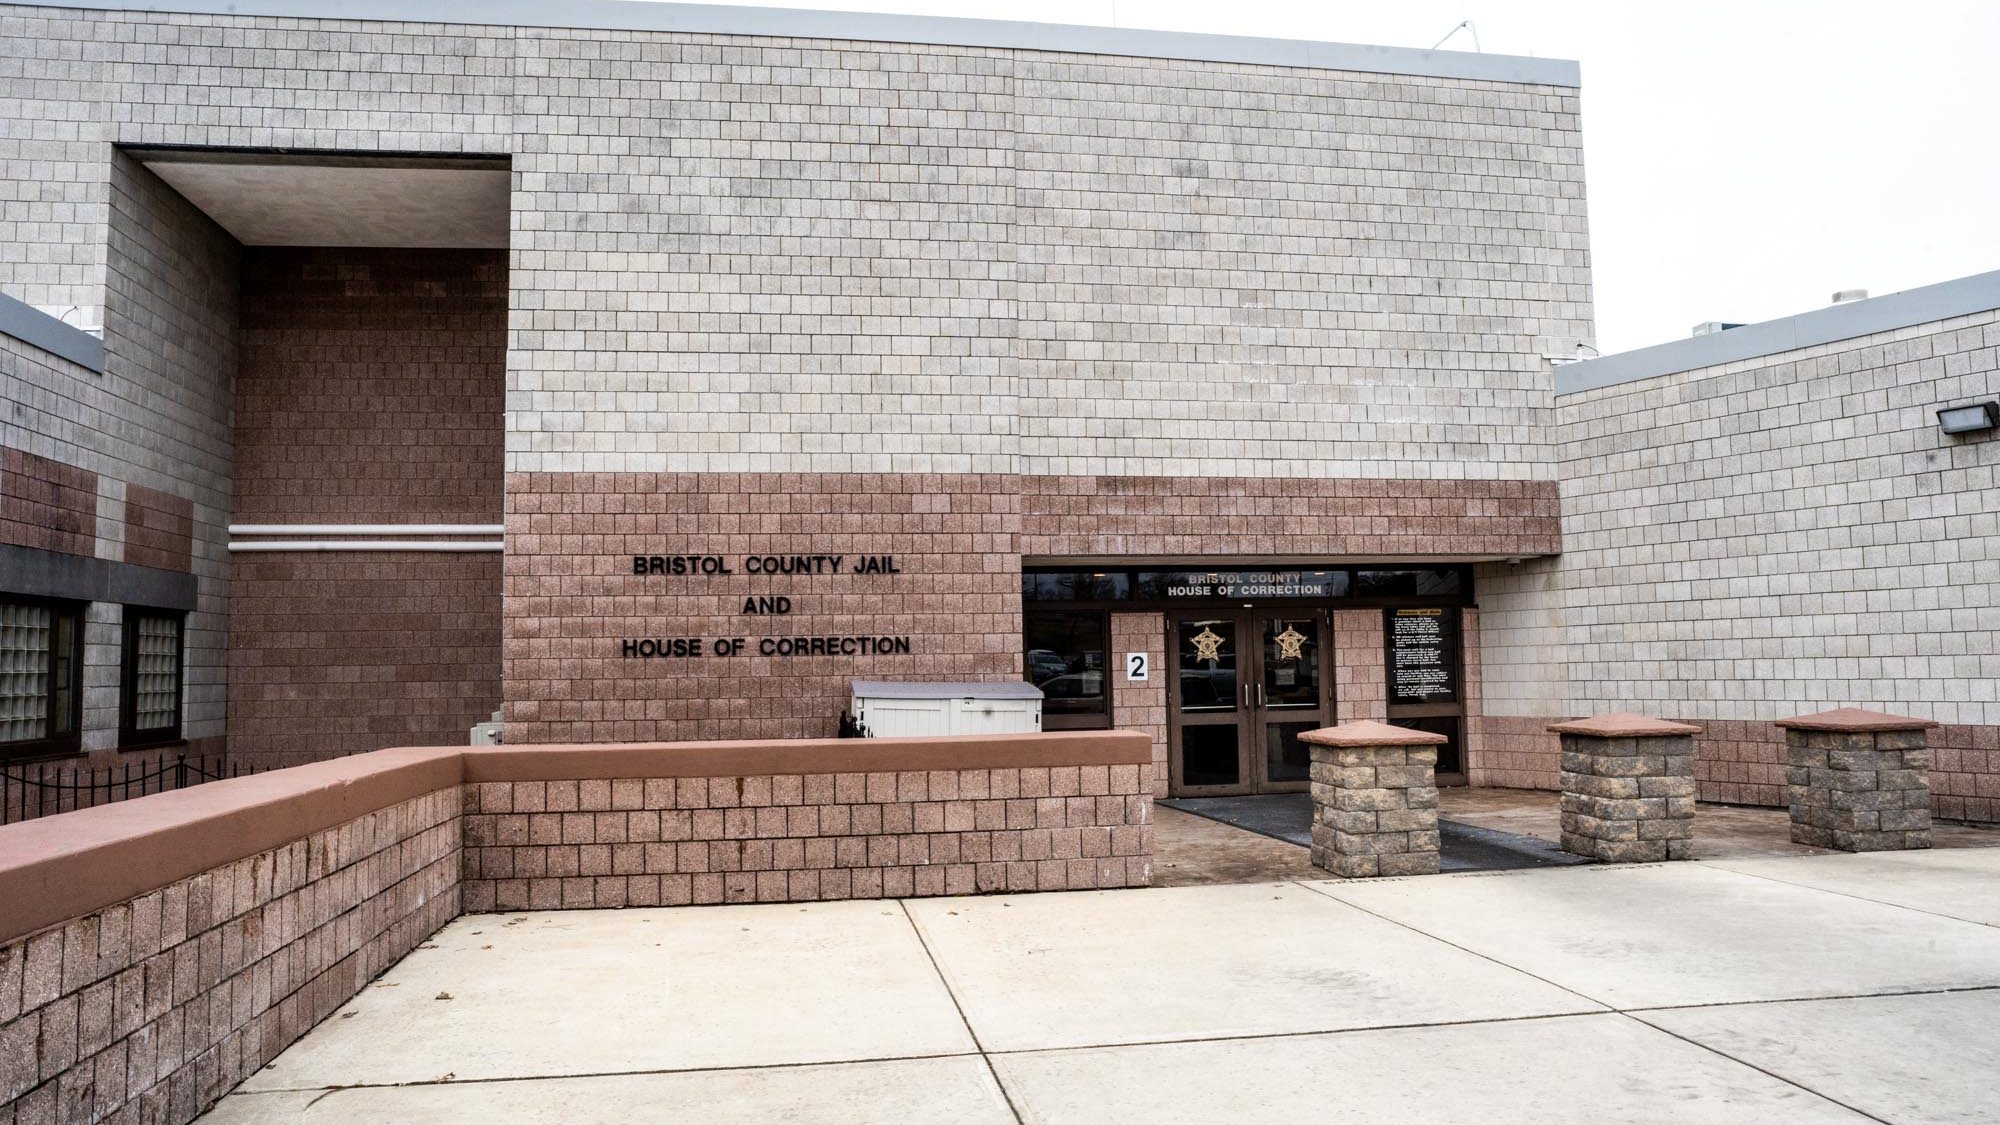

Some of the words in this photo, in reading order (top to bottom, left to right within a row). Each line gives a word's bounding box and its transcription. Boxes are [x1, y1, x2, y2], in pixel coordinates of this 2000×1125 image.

[633, 556, 731, 575] BRISTOL
[746, 555, 842, 574] COUNTY
[854, 555, 900, 574] JAIL
[1189, 574, 1243, 584] BRISTOL
[1250, 573, 1301, 584] COUNTY
[1168, 586, 1211, 596] HOUSE
[1218, 586, 1235, 596] OF
[1241, 585, 1322, 595] CORRECTION
[743, 596, 791, 615] AND
[622, 638, 702, 657] HOUSE
[714, 638, 745, 656] OF
[759, 636, 910, 656] CORRECTION
[1130, 655, 1145, 677] 2
